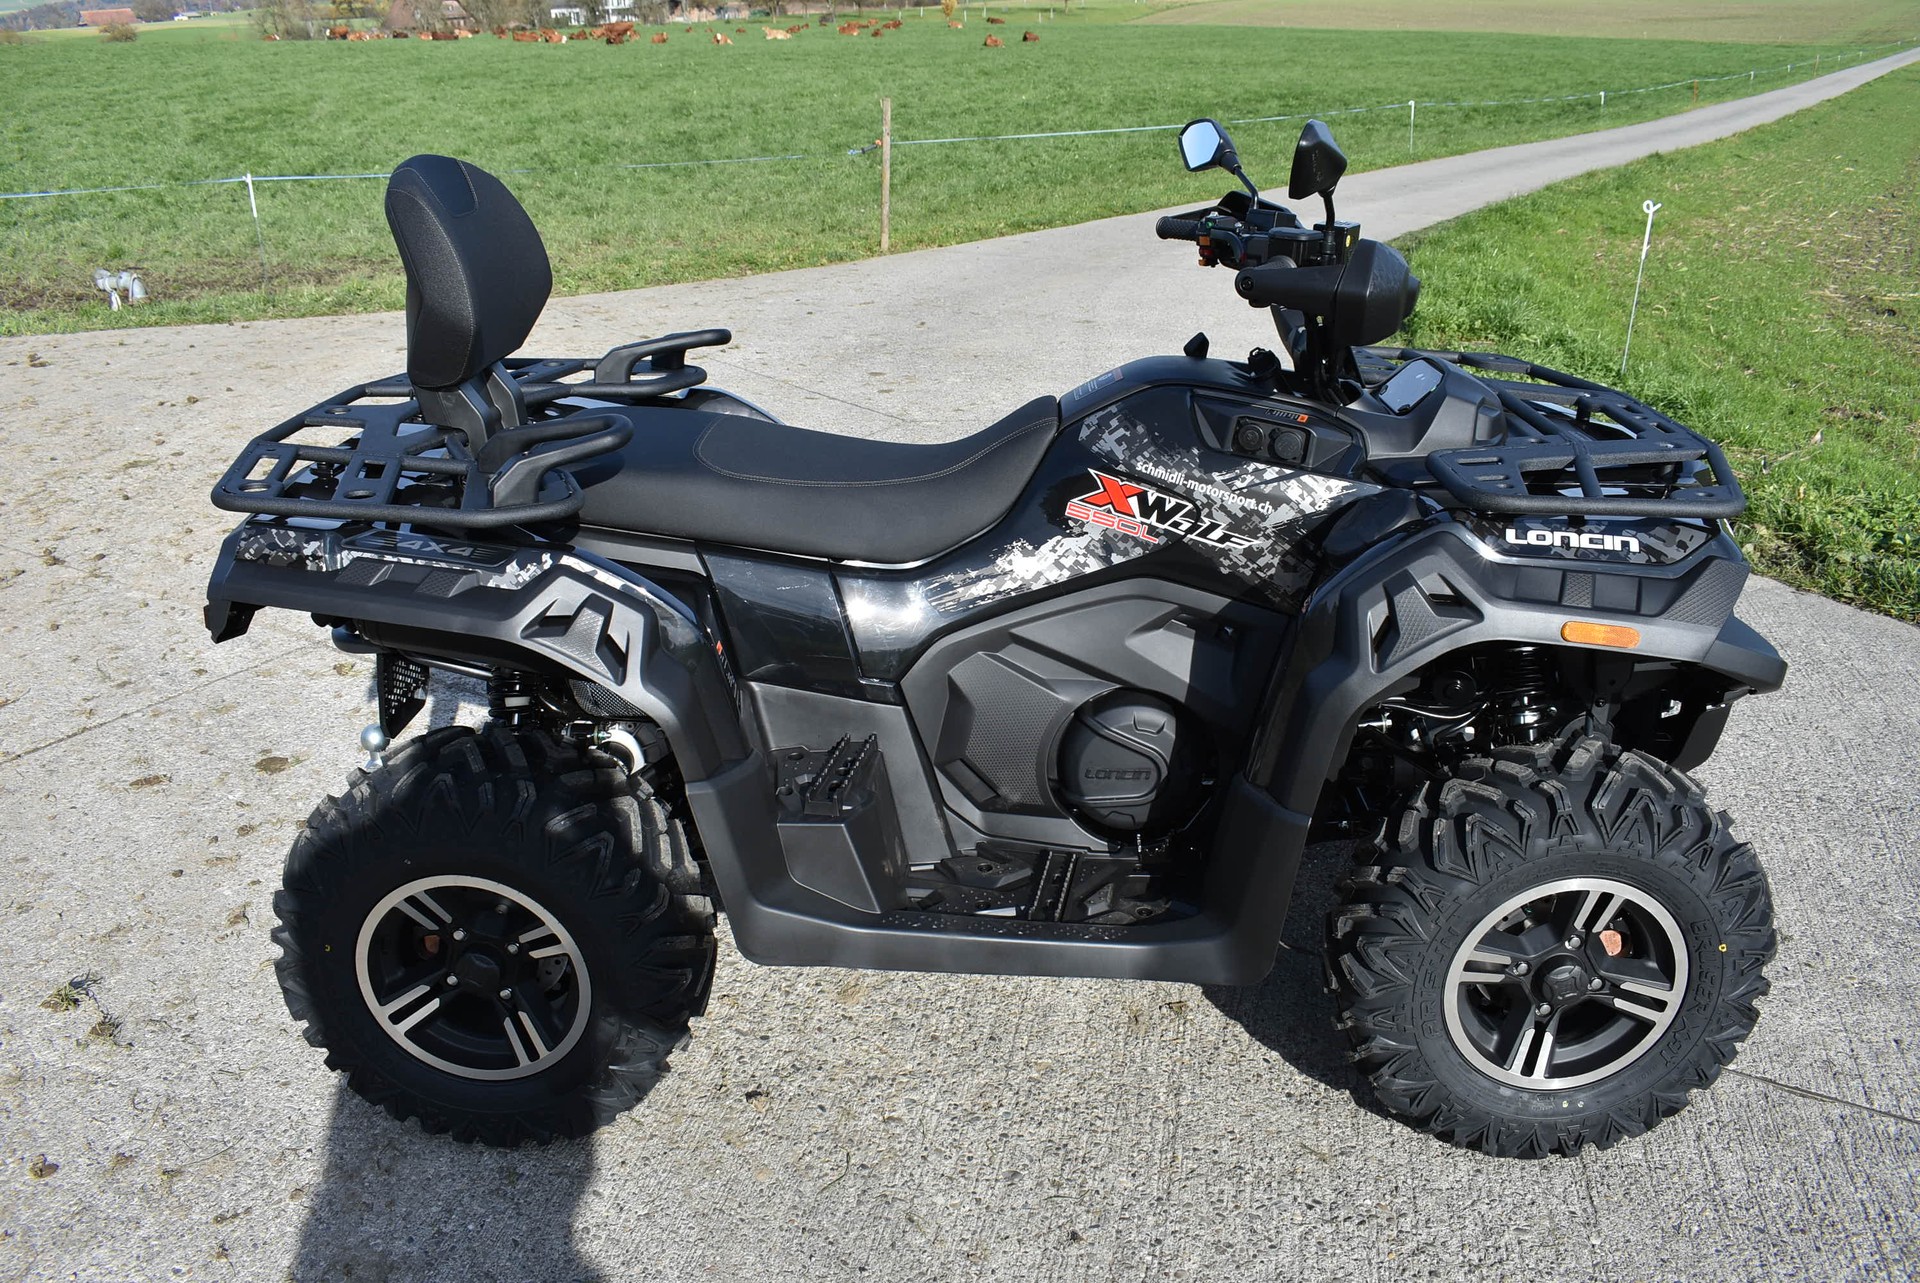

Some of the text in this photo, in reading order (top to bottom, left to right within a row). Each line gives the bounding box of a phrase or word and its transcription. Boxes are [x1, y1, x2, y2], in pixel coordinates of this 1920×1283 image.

[1135, 460, 1274, 516] schmidli-motorsport.ch
[1505, 527, 1640, 553] LONCIN
[1084, 767, 1152, 780] LONCIN
